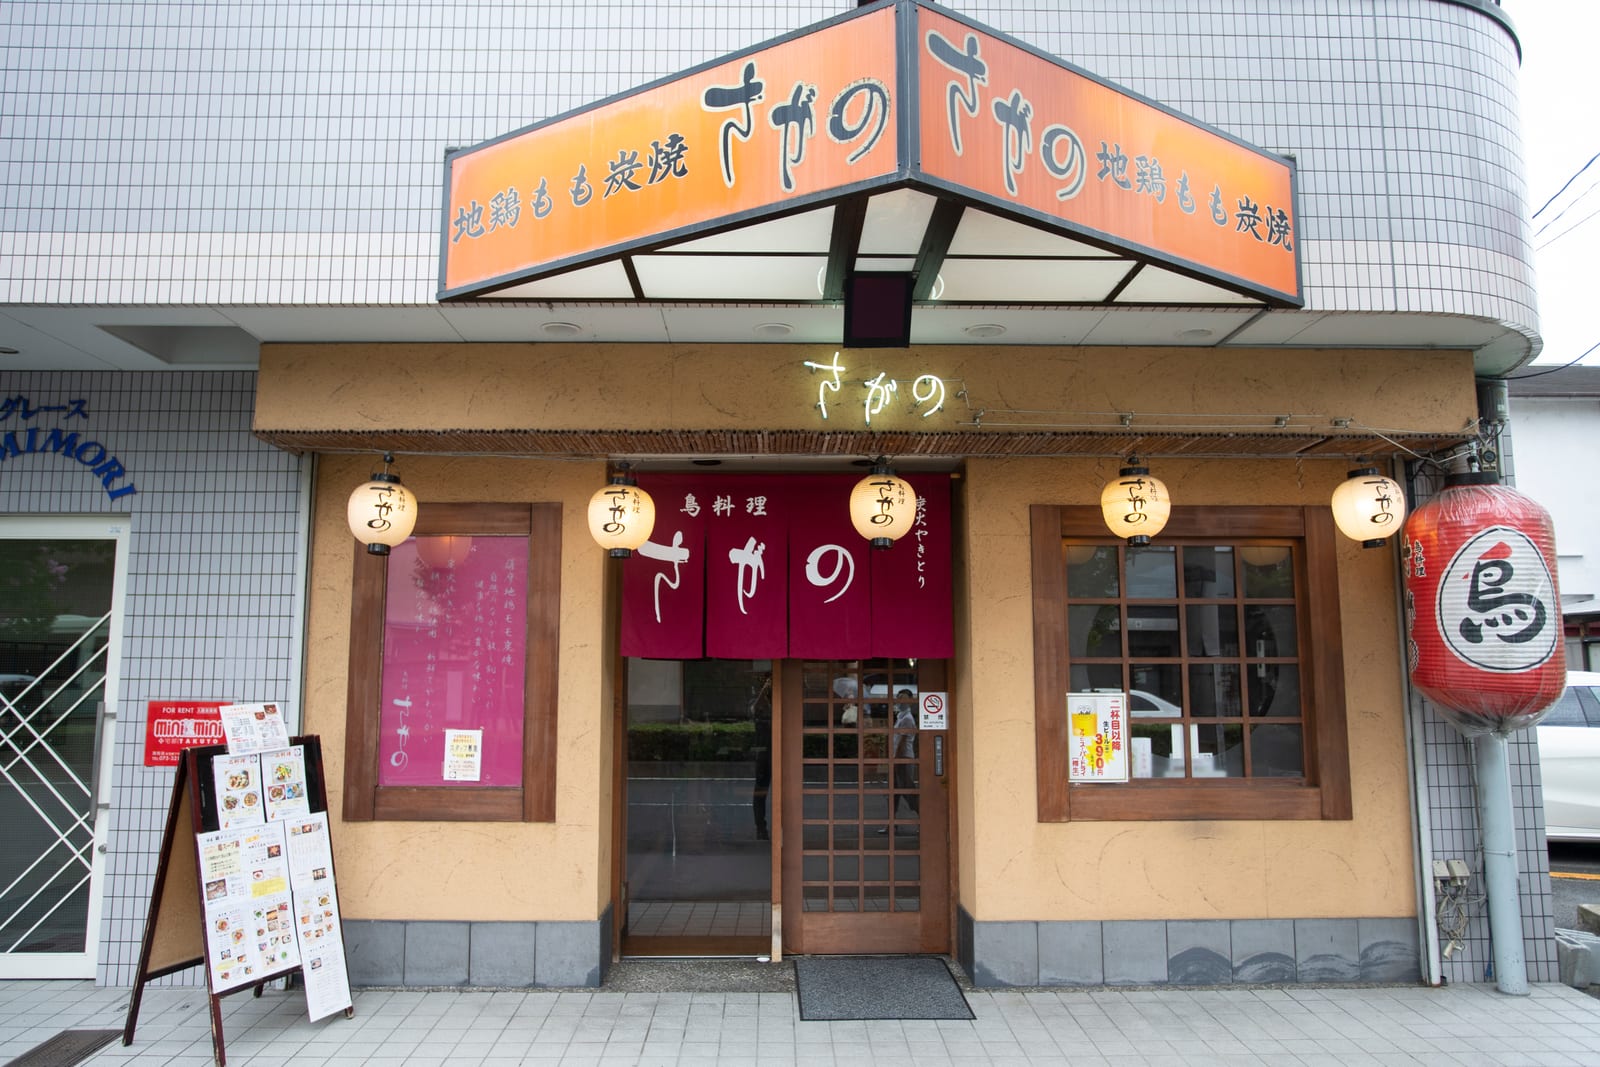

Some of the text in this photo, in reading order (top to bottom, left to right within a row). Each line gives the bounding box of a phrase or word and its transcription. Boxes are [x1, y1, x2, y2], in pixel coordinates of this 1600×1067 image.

[703, 60, 891, 192] さがの
[926, 33, 1086, 201] さがの
[453, 134, 689, 243] 地鶏もも炭焼
[1096, 141, 1293, 252] 地鶏もも炭焼
[804, 351, 945, 425] さがの
[603, 488, 630, 536] さがの
[680, 493, 768, 517] 鳥料理
[870, 480, 895, 527] さがの
[1119, 478, 1148, 526] さがの
[637, 530, 855, 624] さがの
